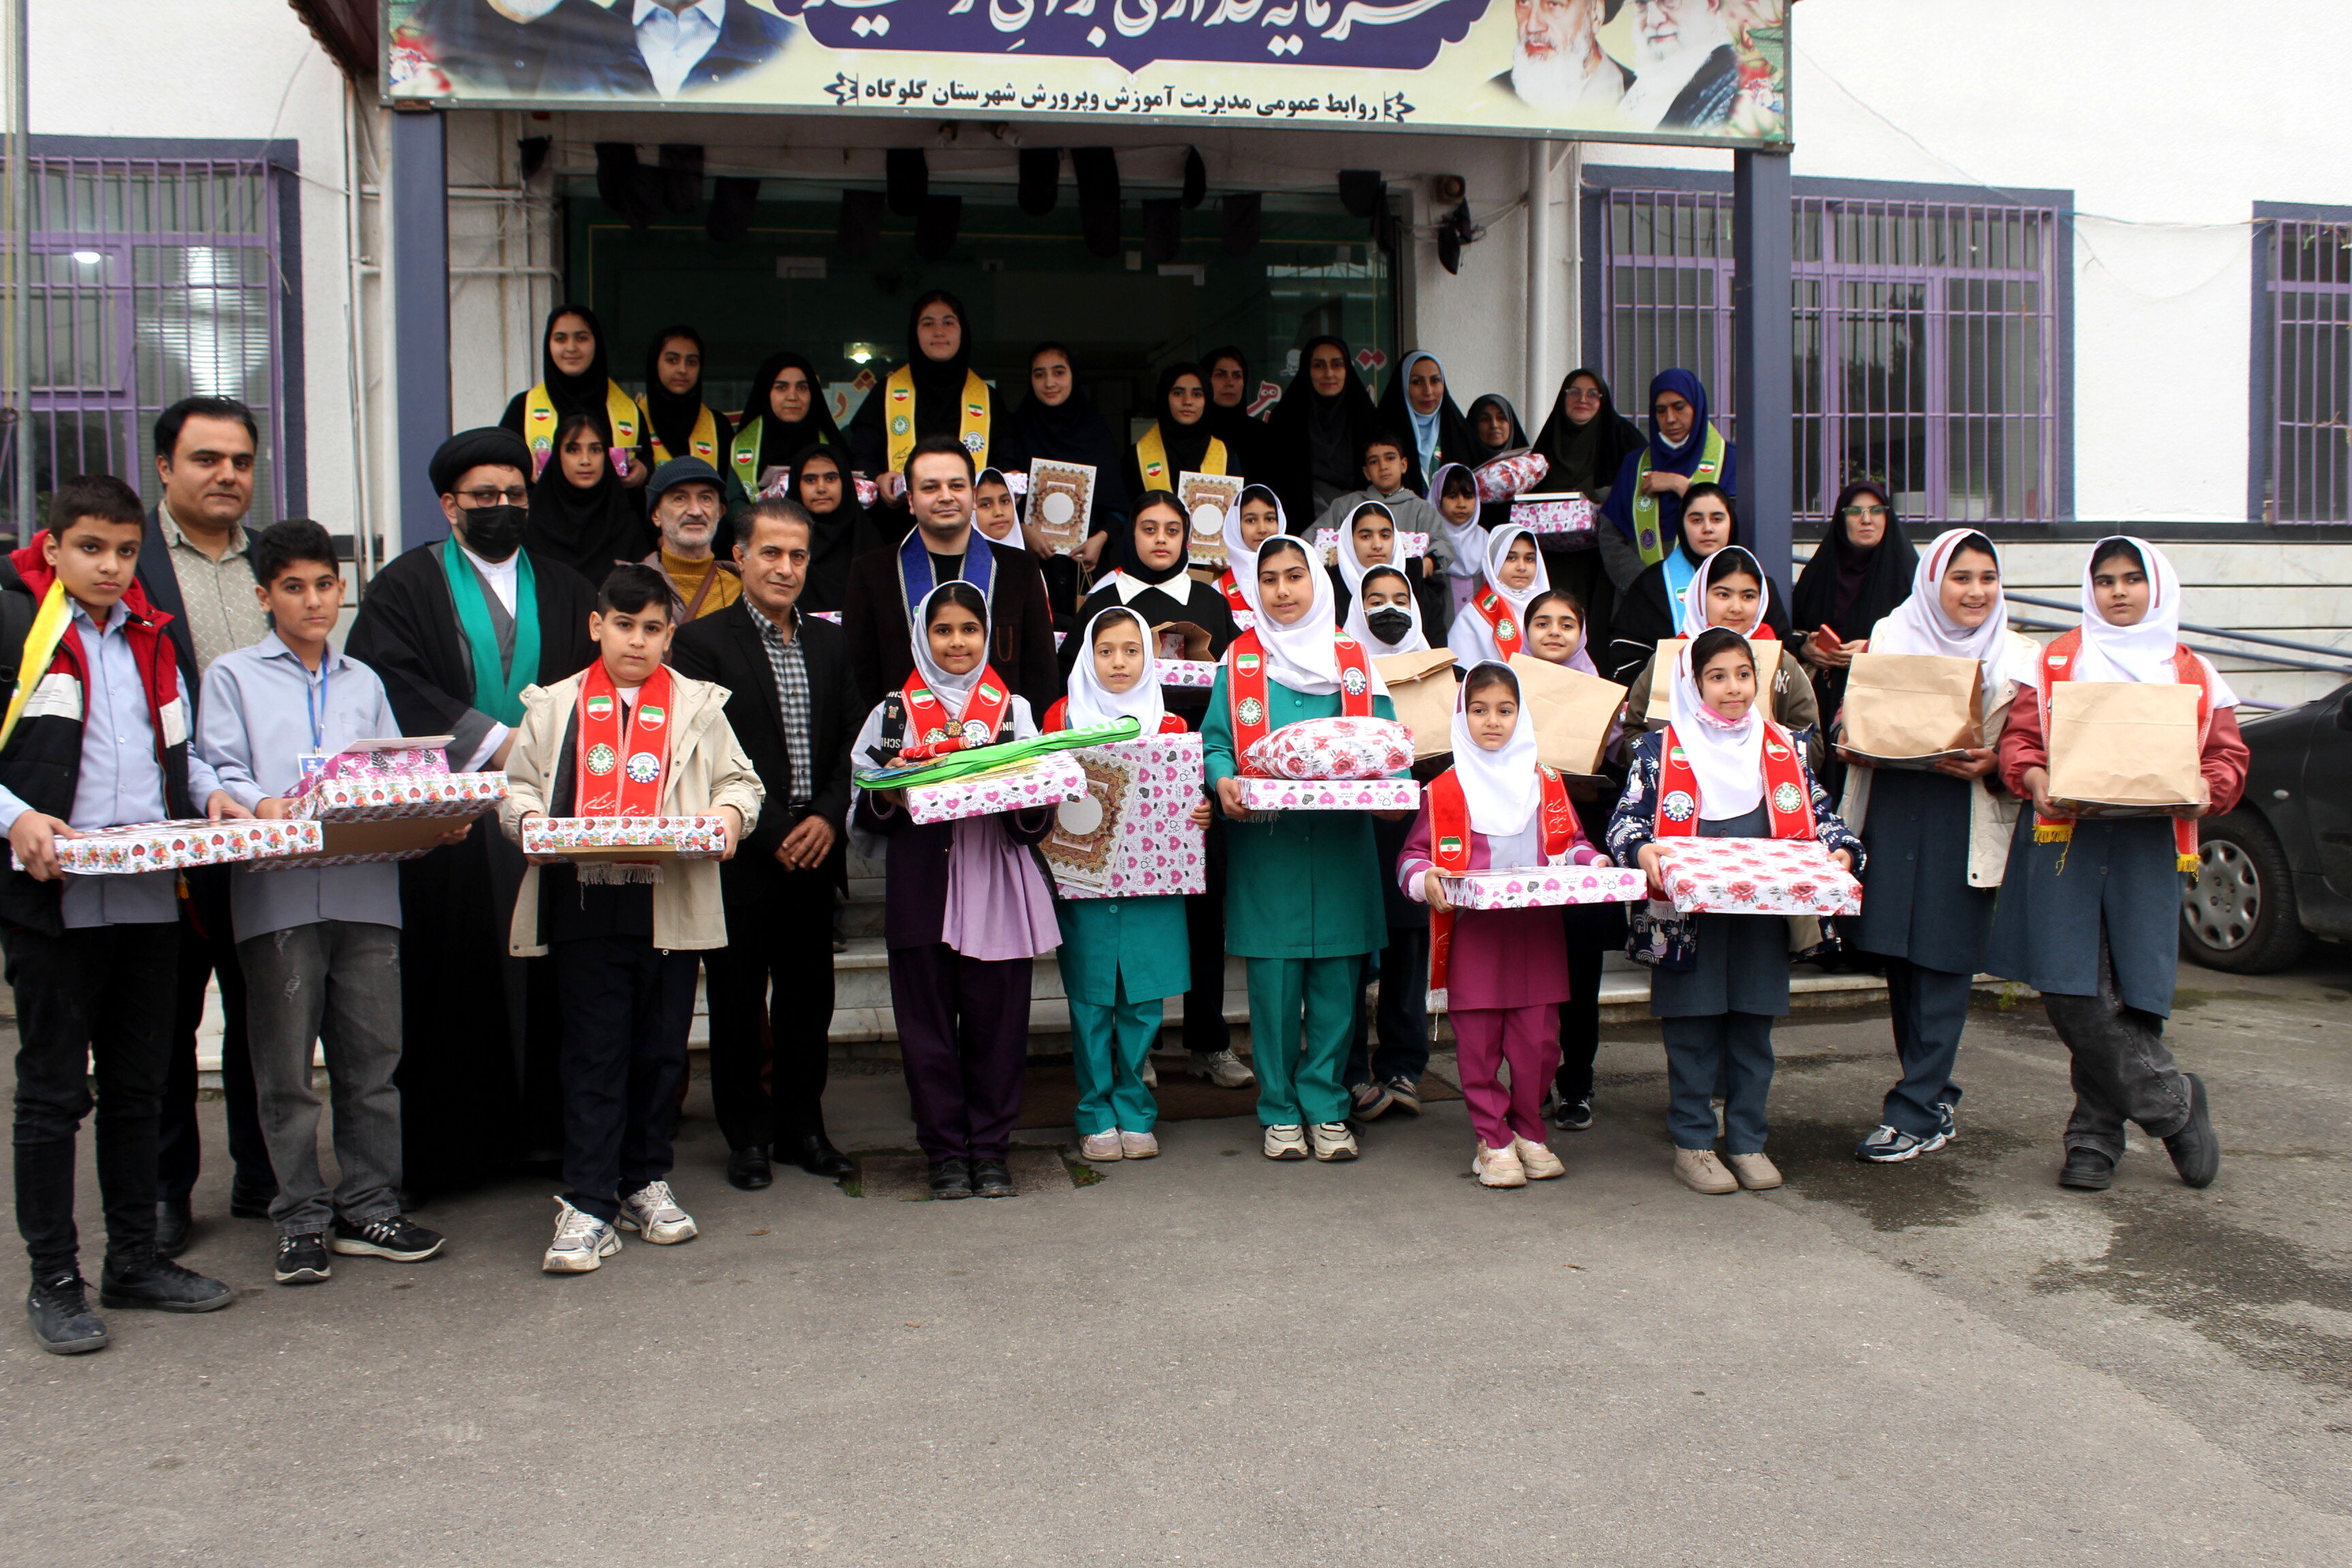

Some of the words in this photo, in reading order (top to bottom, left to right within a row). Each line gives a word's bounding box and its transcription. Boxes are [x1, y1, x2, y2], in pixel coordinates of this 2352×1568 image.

[864, 78, 927, 105] گلوگاه
[932, 80, 1015, 108] شهرستان
[1104, 84, 1175, 112] آموزش
[1180, 91, 1252, 115] مدیریت
[1256, 97, 1320, 118] عمومی
[1324, 93, 1377, 120] روابط
[1073, 719, 1130, 736] CUP
